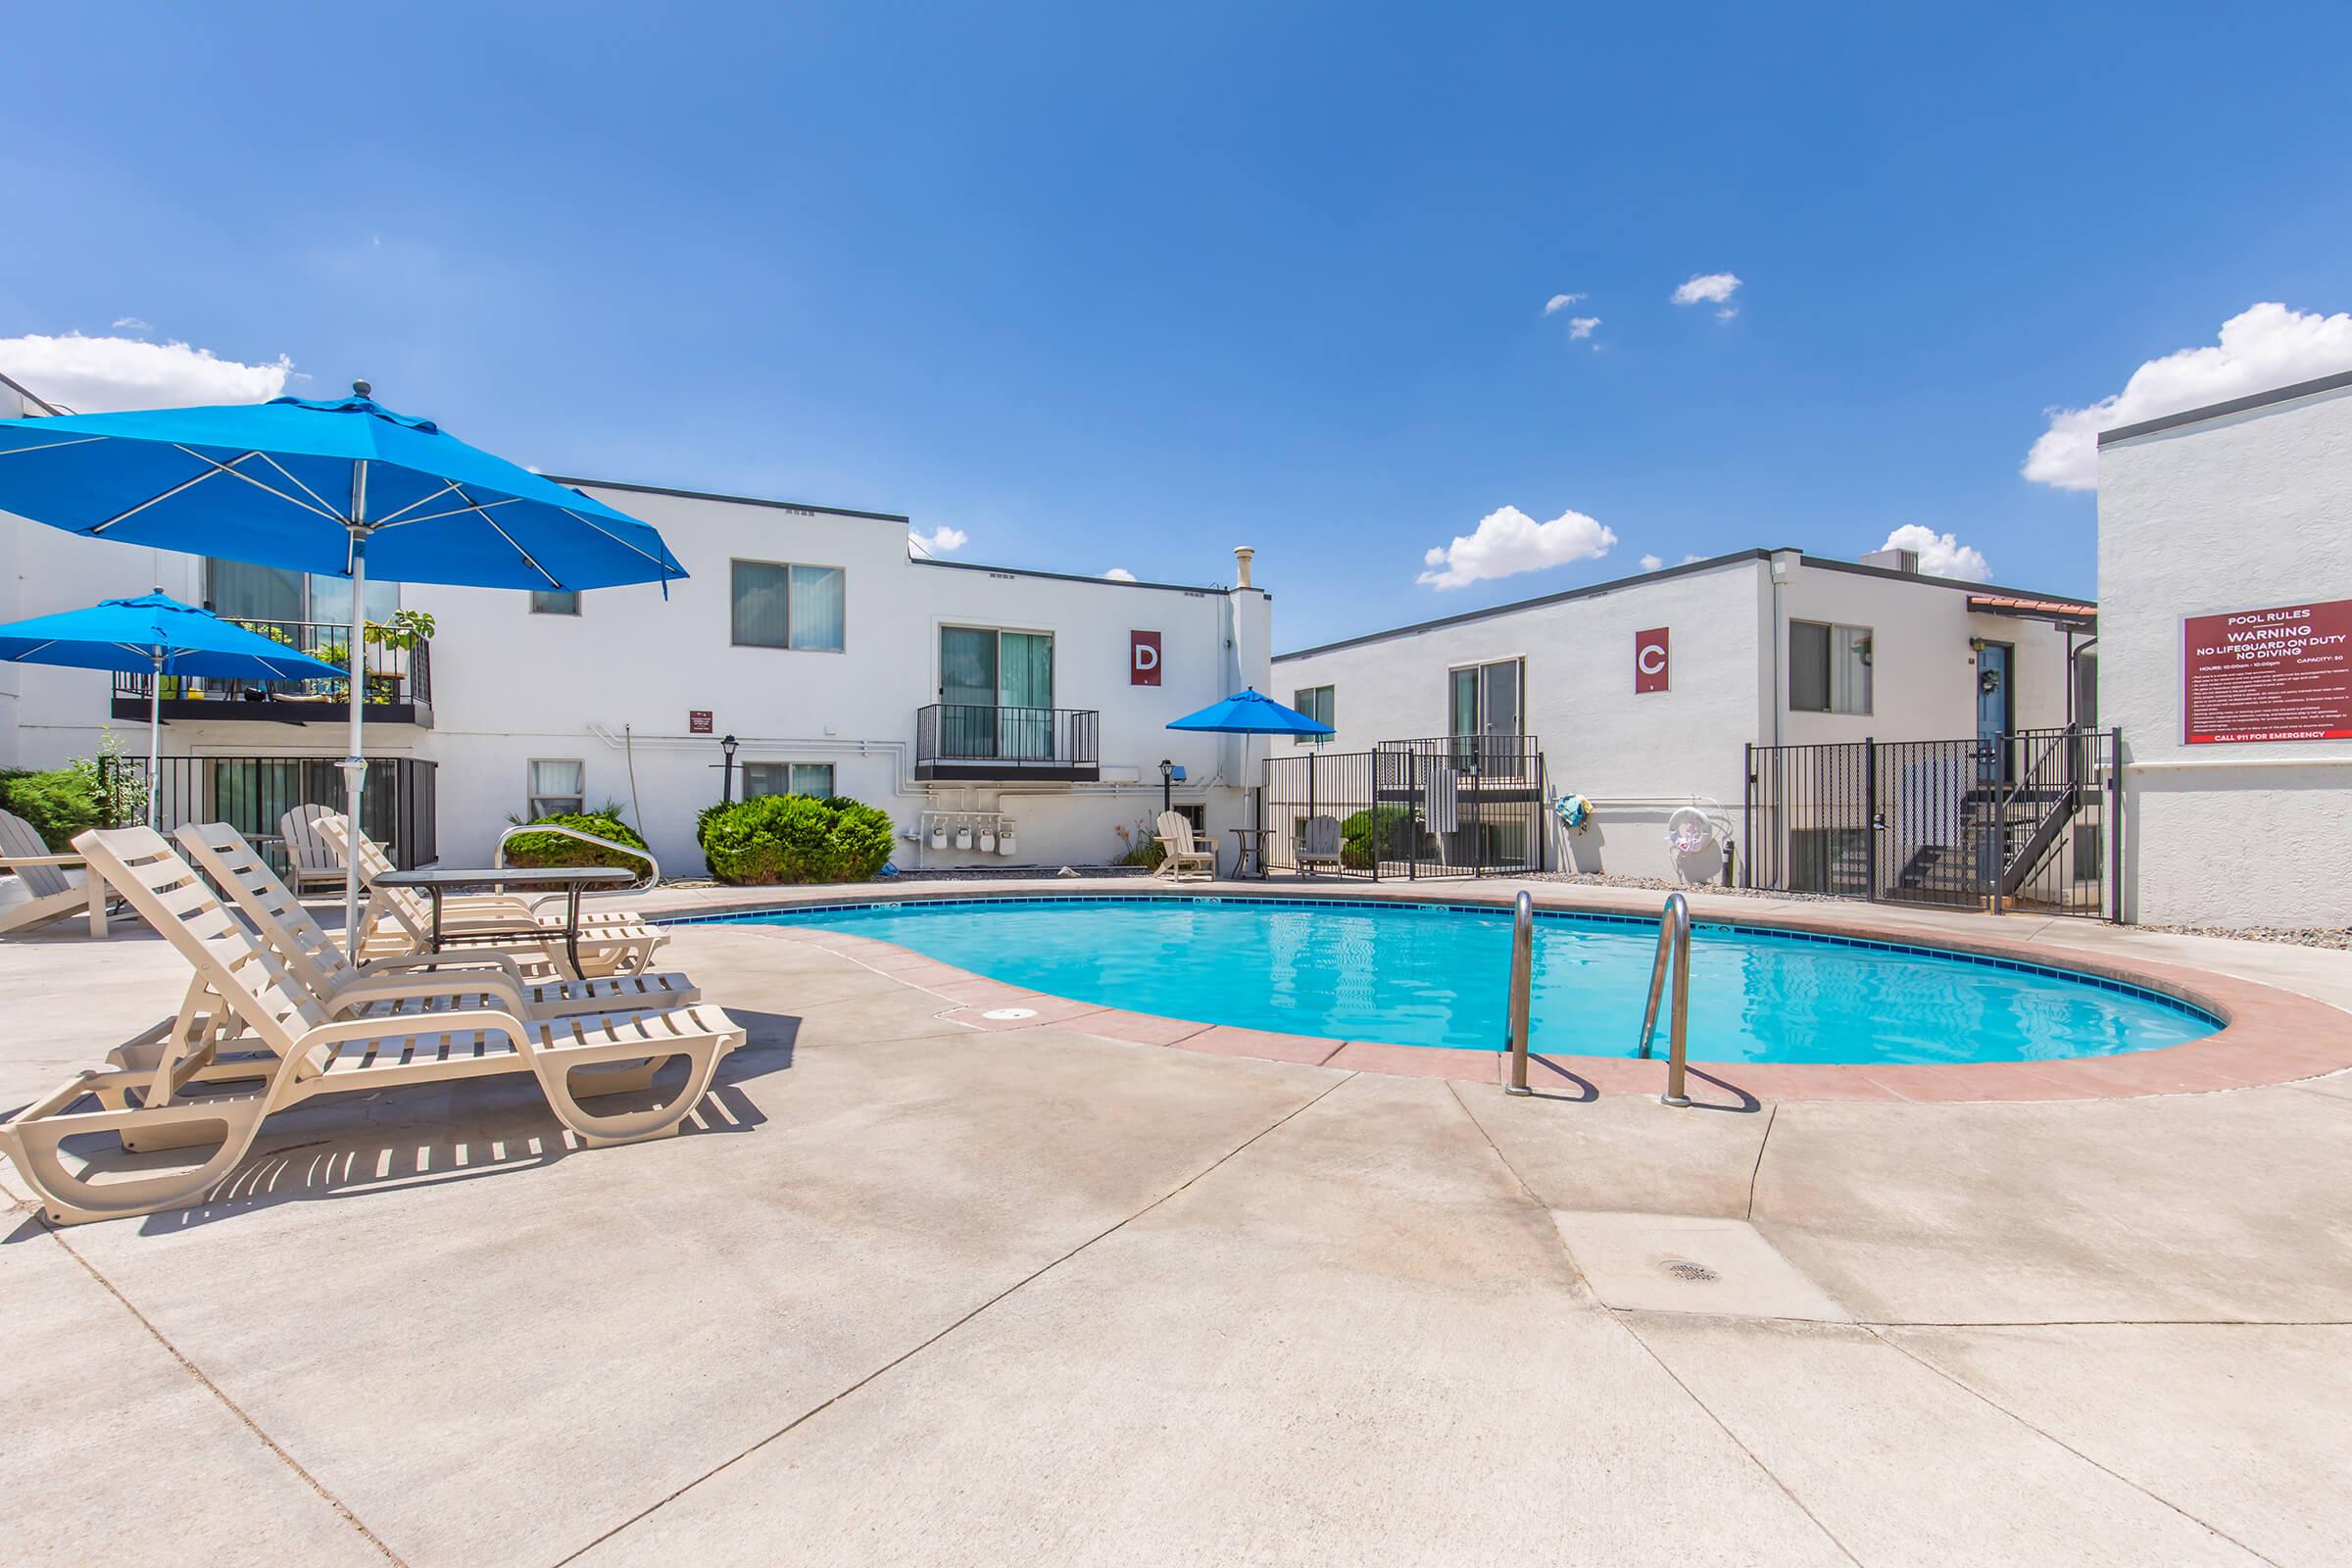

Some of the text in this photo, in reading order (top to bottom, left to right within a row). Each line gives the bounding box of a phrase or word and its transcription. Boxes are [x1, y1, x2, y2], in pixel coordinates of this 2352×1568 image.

[2228, 610, 2311, 625] POOL RULES
[2228, 625, 2312, 643] WARNING
[2197, 635, 2346, 656] NO LIFEGUARD ON DUTY
[2236, 648, 2301, 660] NO DIVING
[1136, 644, 1158, 670] D
[1639, 645, 1666, 674] C
